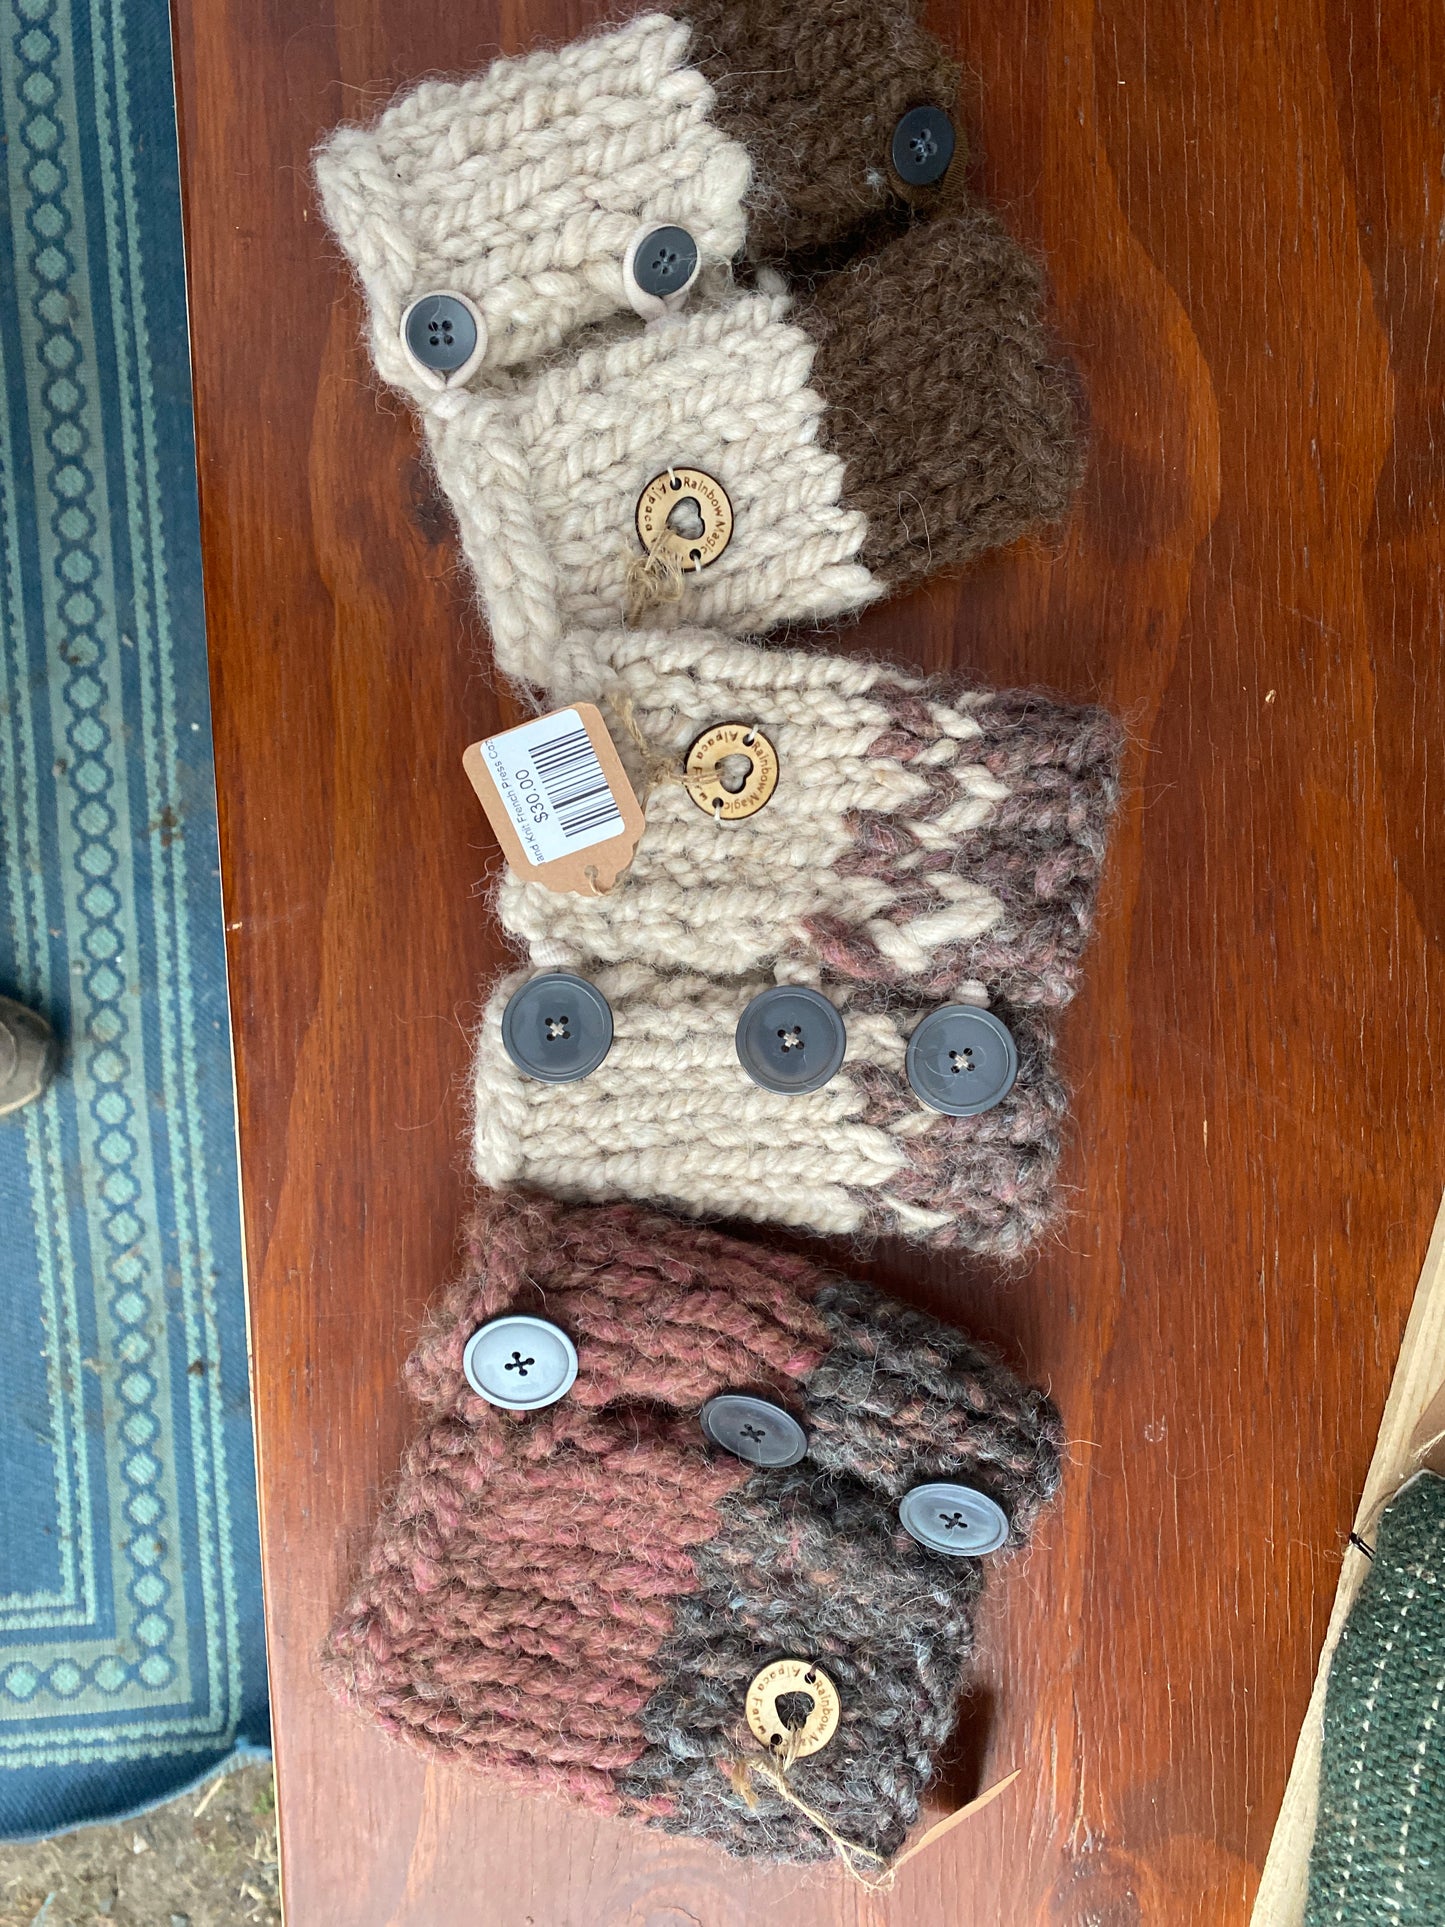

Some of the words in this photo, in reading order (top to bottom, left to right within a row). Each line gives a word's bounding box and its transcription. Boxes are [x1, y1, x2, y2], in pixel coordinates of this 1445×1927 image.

[644, 478, 667, 532] Alpaca
[683, 476, 723, 517] Rainbow
[701, 520, 726, 555] Magic
[696, 730, 738, 760] Alpaca
[495, 760, 512, 789] Press
[751, 741, 772, 793] Rainbow
[507, 790, 527, 823] French
[515, 769, 549, 823] $30.00
[723, 792, 760, 814] Magic
[521, 823, 536, 843] Knit
[530, 844, 546, 866] and
[757, 1664, 801, 1691] Alpaca
[752, 1696, 767, 1735] Farm
[814, 1680, 834, 1734] Rainbow
